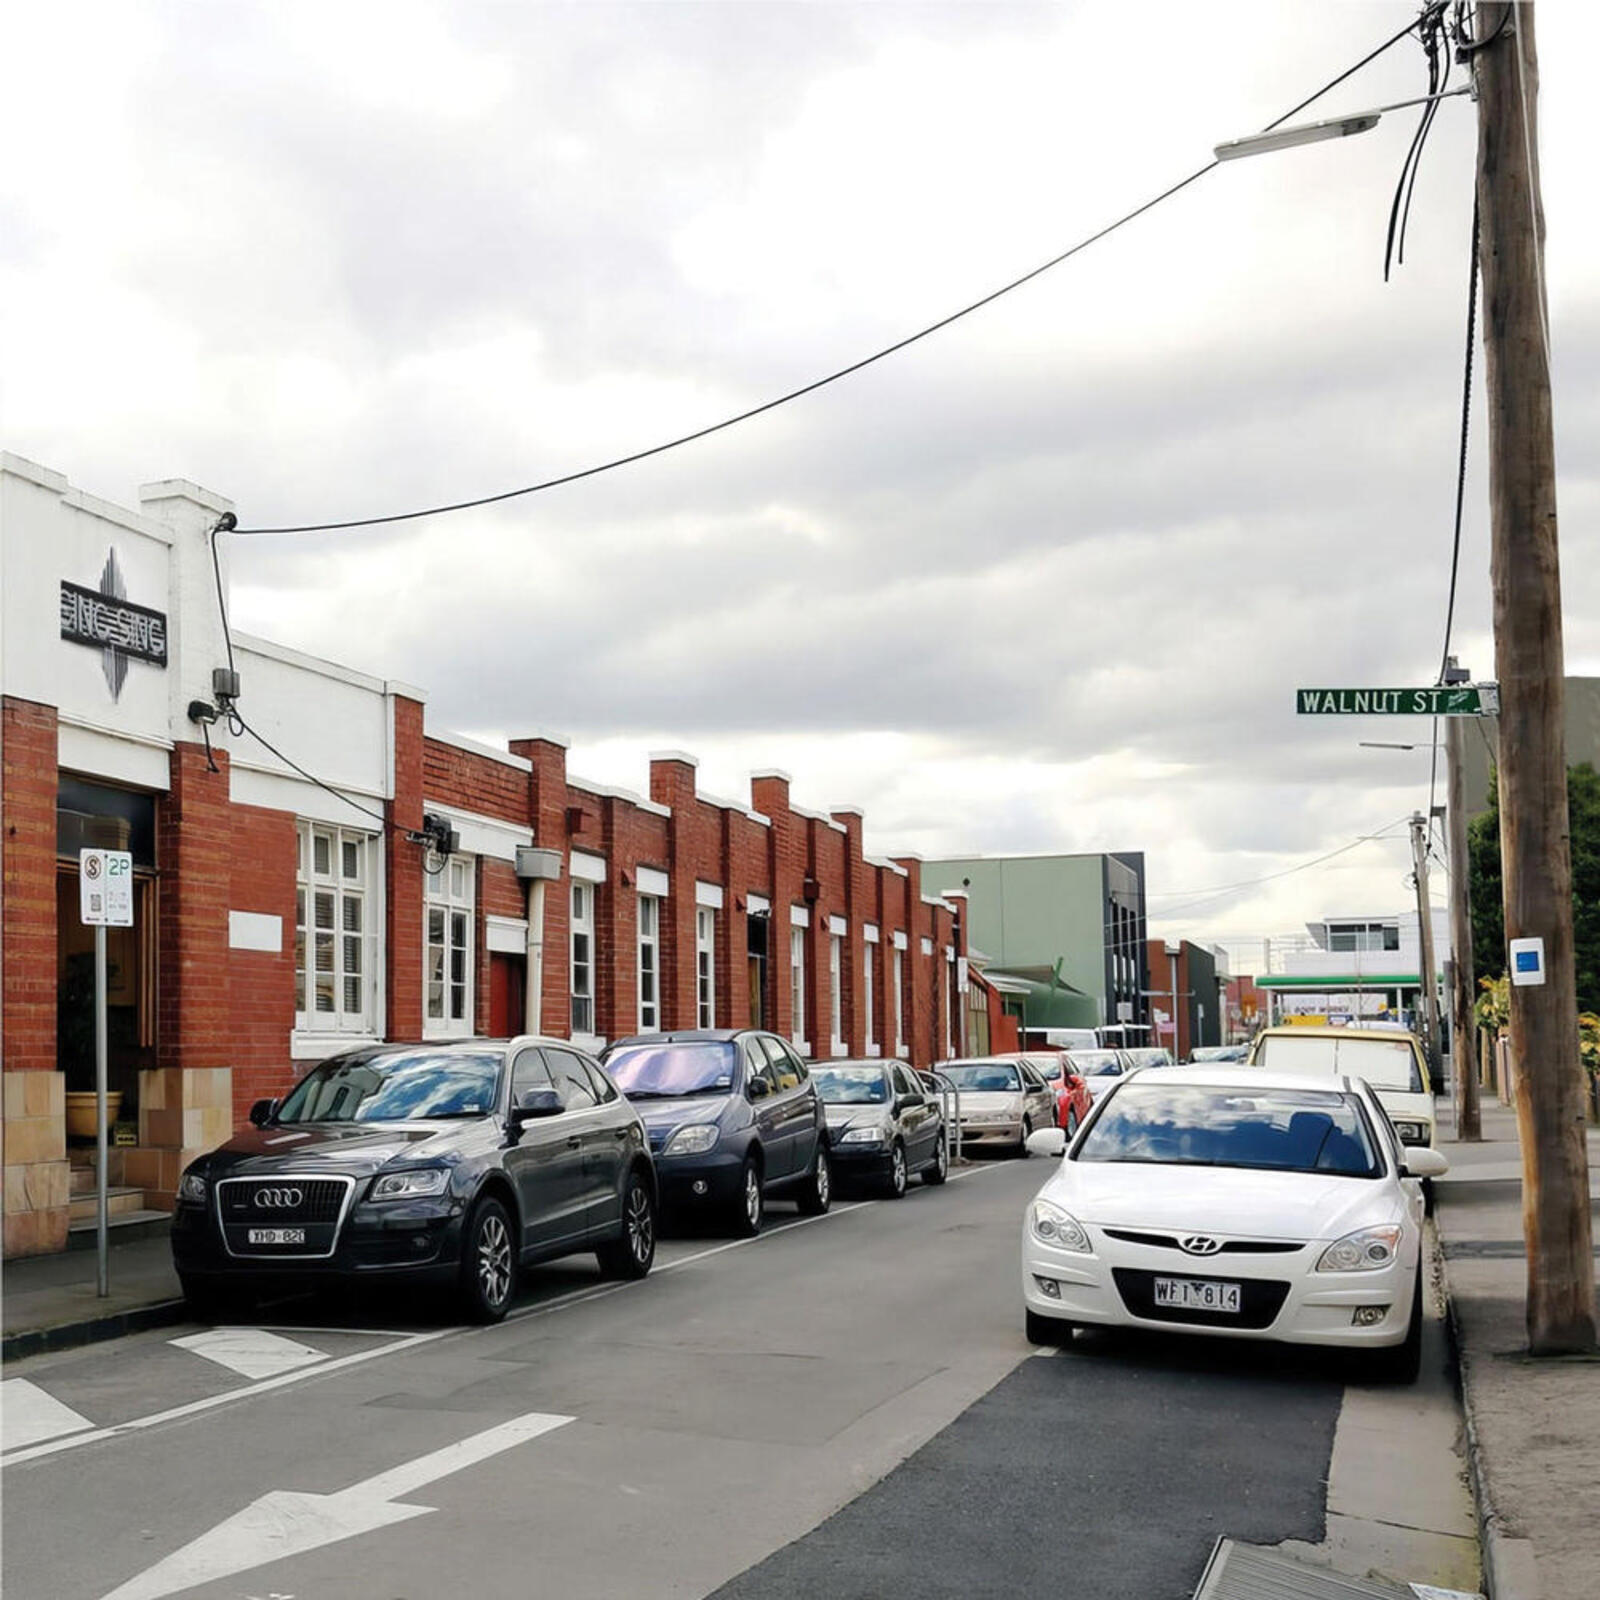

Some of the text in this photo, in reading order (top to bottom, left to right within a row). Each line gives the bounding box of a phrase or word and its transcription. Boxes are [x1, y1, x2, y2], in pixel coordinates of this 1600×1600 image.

[1302, 690, 1442, 713] WALNUT ST
[109, 858, 130, 876] 2P
